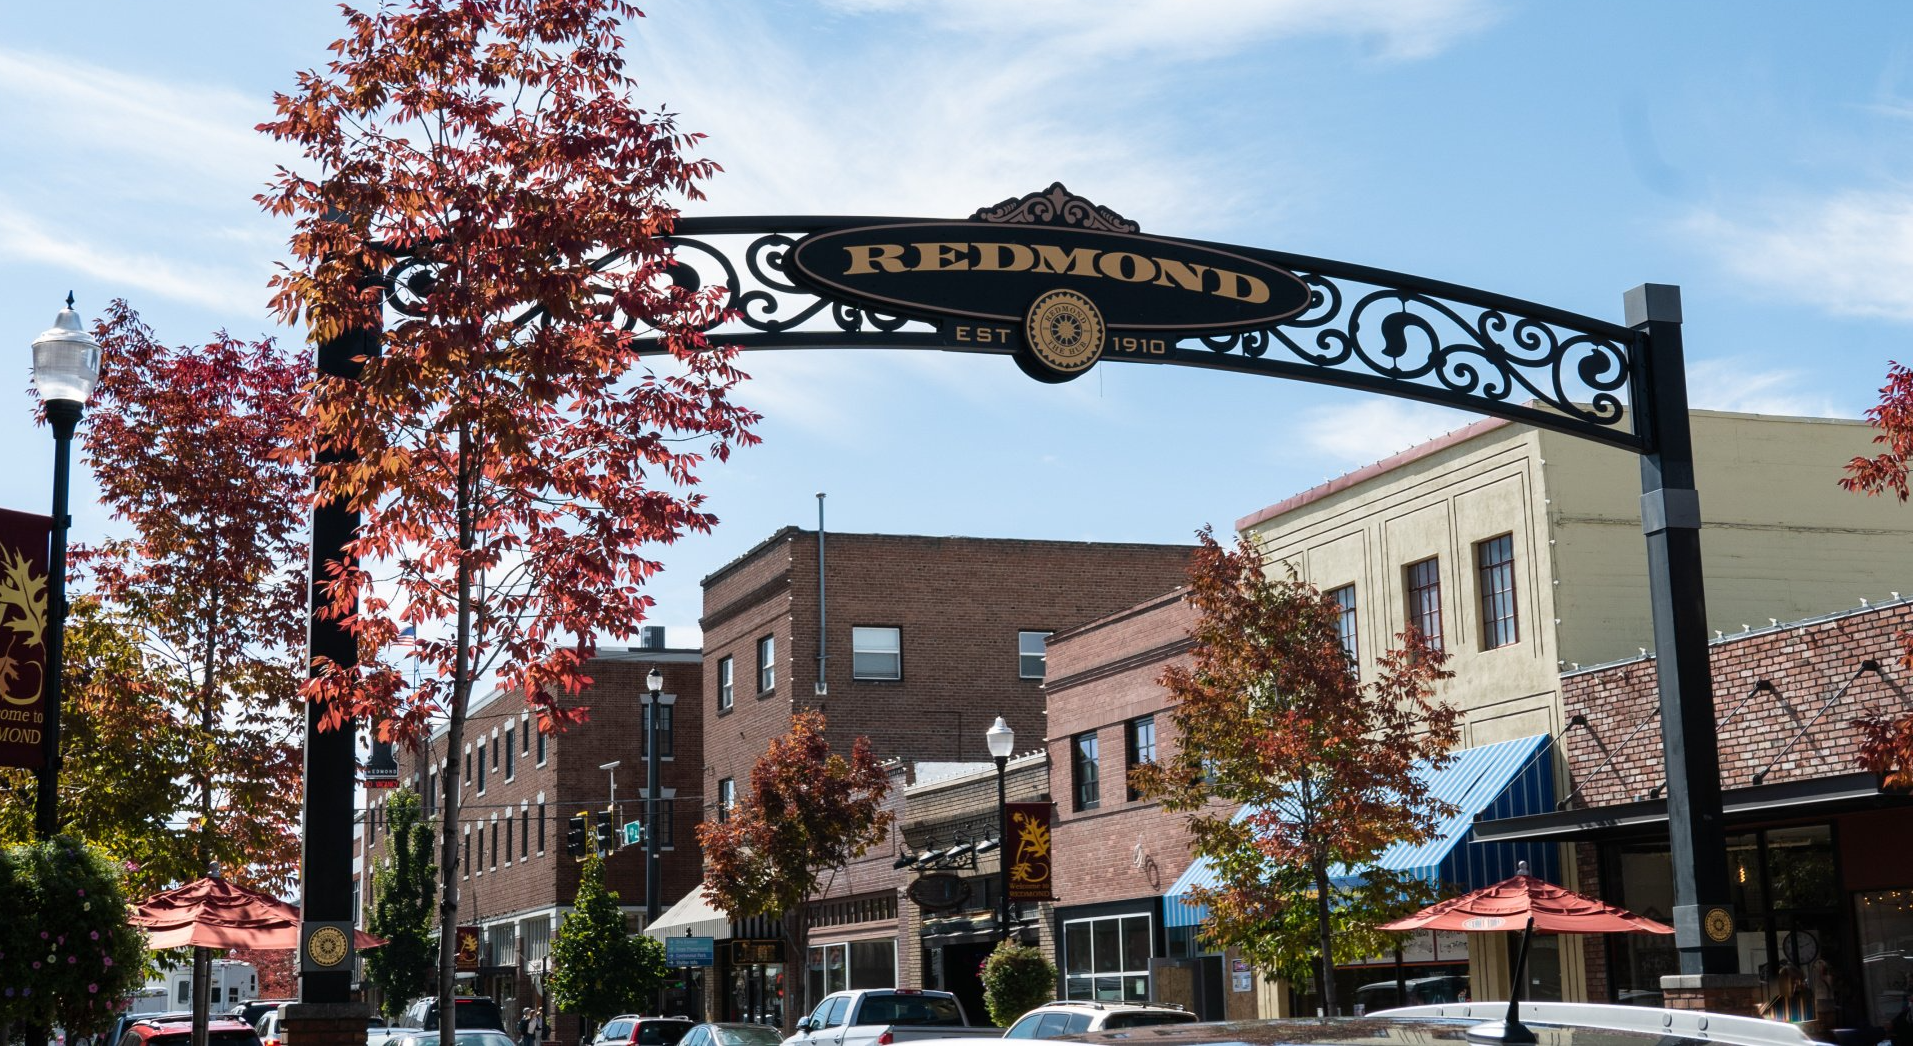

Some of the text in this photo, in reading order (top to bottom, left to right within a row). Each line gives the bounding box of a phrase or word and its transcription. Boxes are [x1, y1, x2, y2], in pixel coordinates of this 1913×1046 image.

[843, 242, 1270, 304] REDMOND
[1045, 305, 1087, 324] REDMOND
[956, 326, 1165, 354] EST 1910
[1048, 338, 1087, 355] THE HUB
[0, 709, 43, 723] ome to
